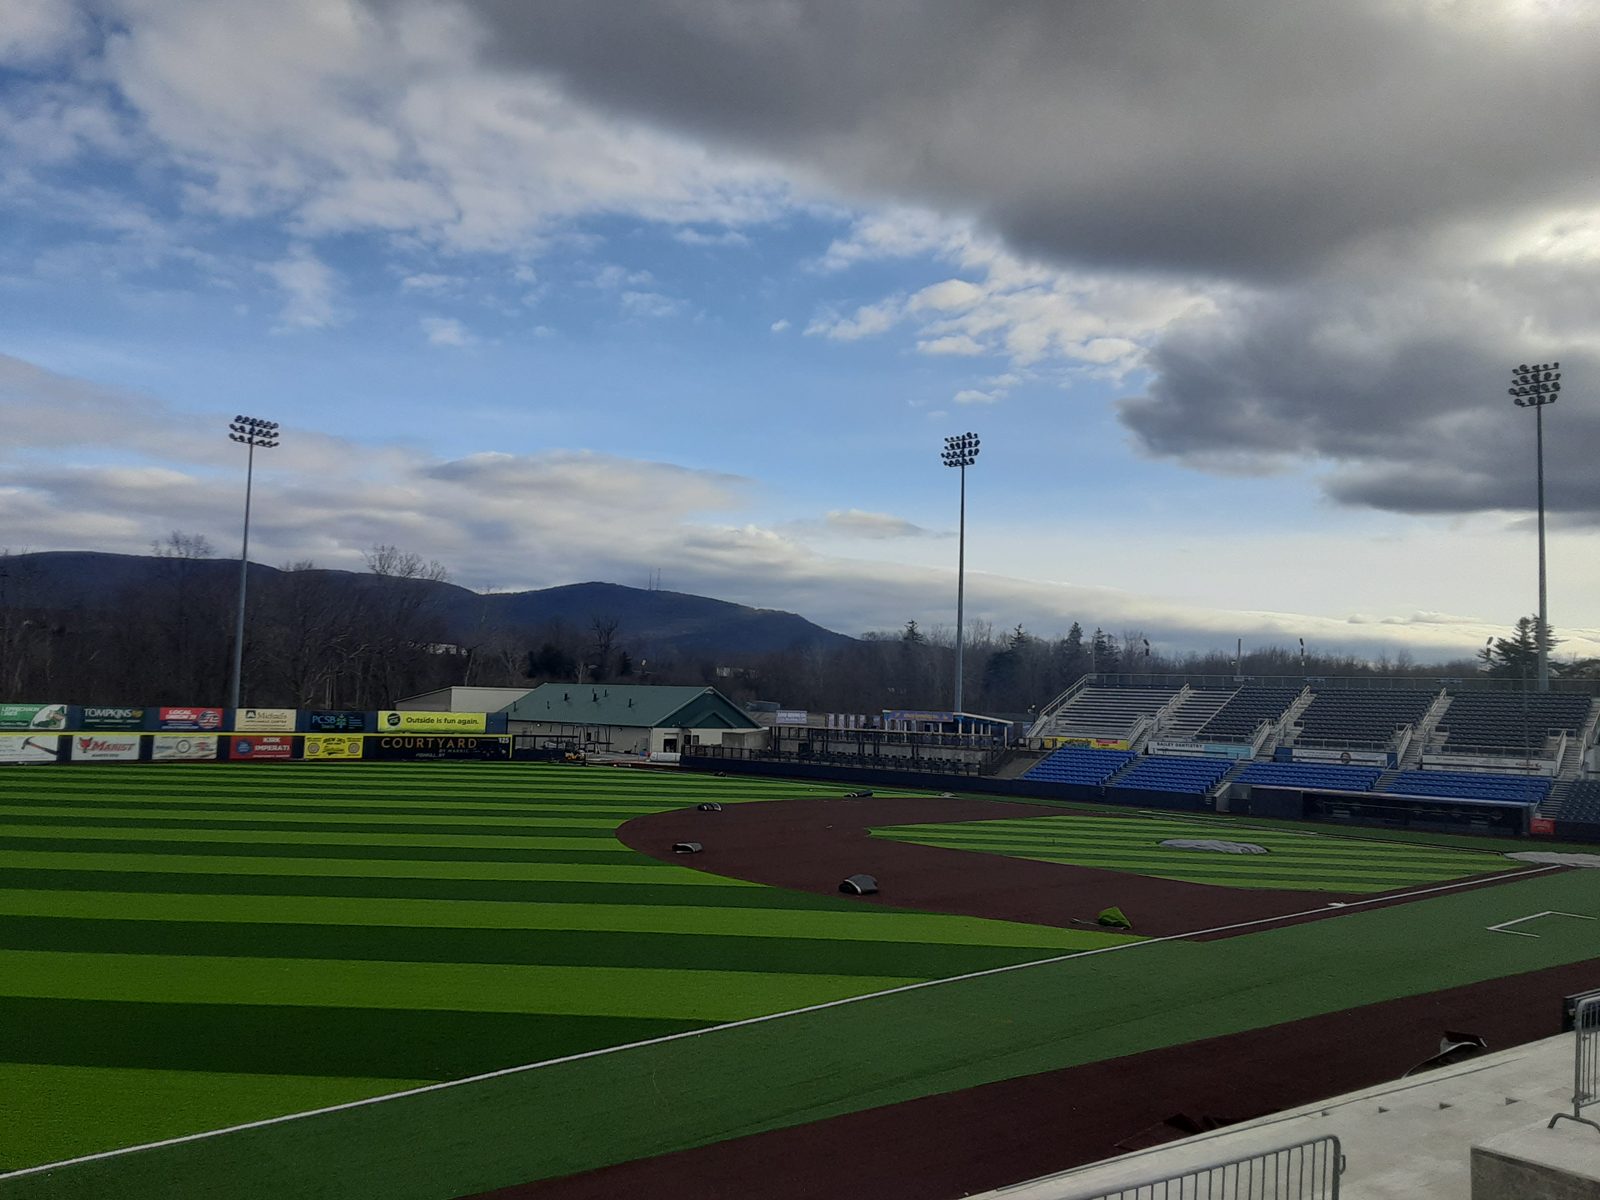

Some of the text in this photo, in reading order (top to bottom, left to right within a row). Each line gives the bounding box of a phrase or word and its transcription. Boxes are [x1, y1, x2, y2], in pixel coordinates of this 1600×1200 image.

[84, 708, 132, 718] TOMPKINS
[406, 716, 435, 724] Outside
[93, 740, 136, 752] MARIST
[381, 737, 478, 748] COURTYARD
